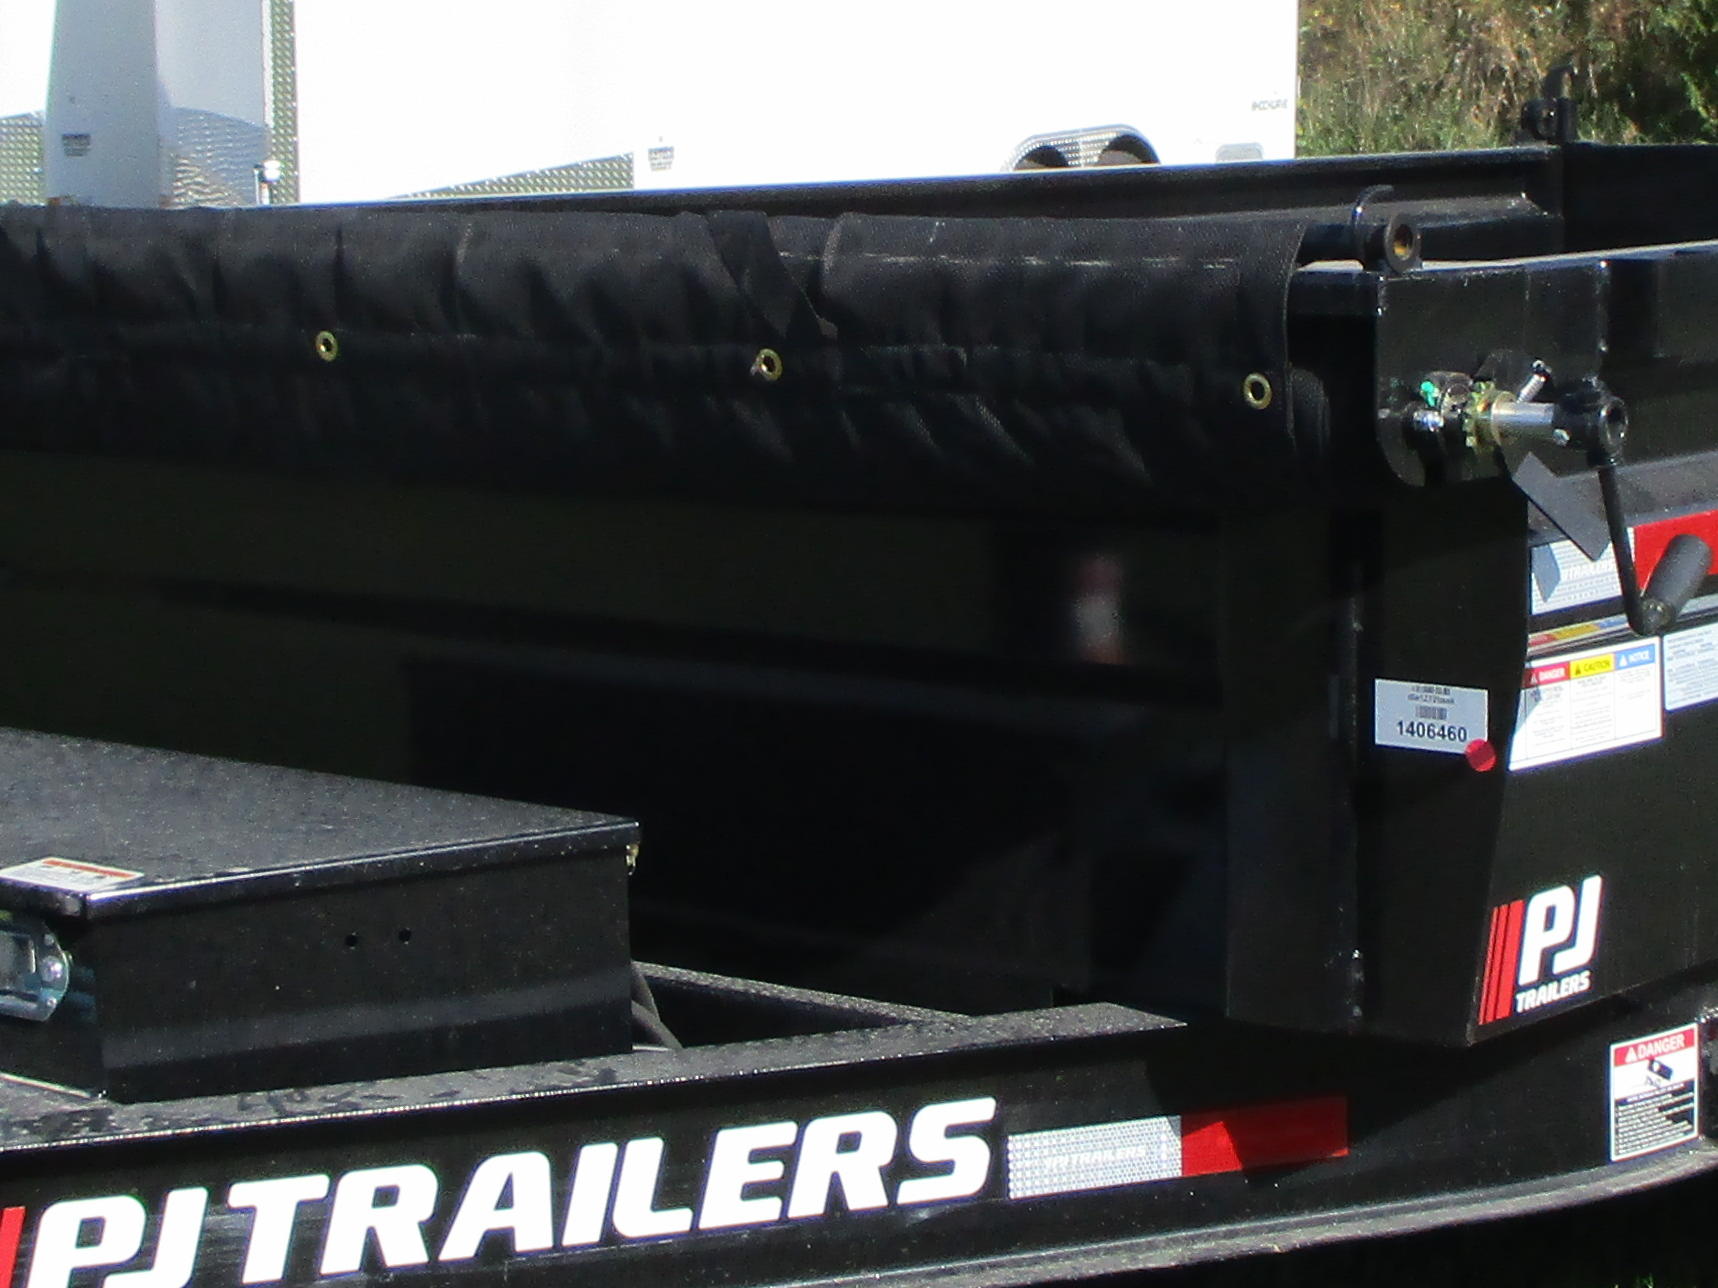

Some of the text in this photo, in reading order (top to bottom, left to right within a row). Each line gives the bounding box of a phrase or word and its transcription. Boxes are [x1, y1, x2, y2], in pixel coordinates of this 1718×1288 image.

[1583, 659, 1611, 672] CAUTION
[1628, 650, 1651, 662] NOTICE
[1538, 667, 1566, 682] DANGER
[1397, 720, 1467, 743] 1406460
[1518, 875, 1602, 986] PJ
[1516, 970, 1591, 1013] TRAILERS
[1636, 1033, 1685, 1060] DANGER
[227, 1096, 997, 1285] TRAILERS
